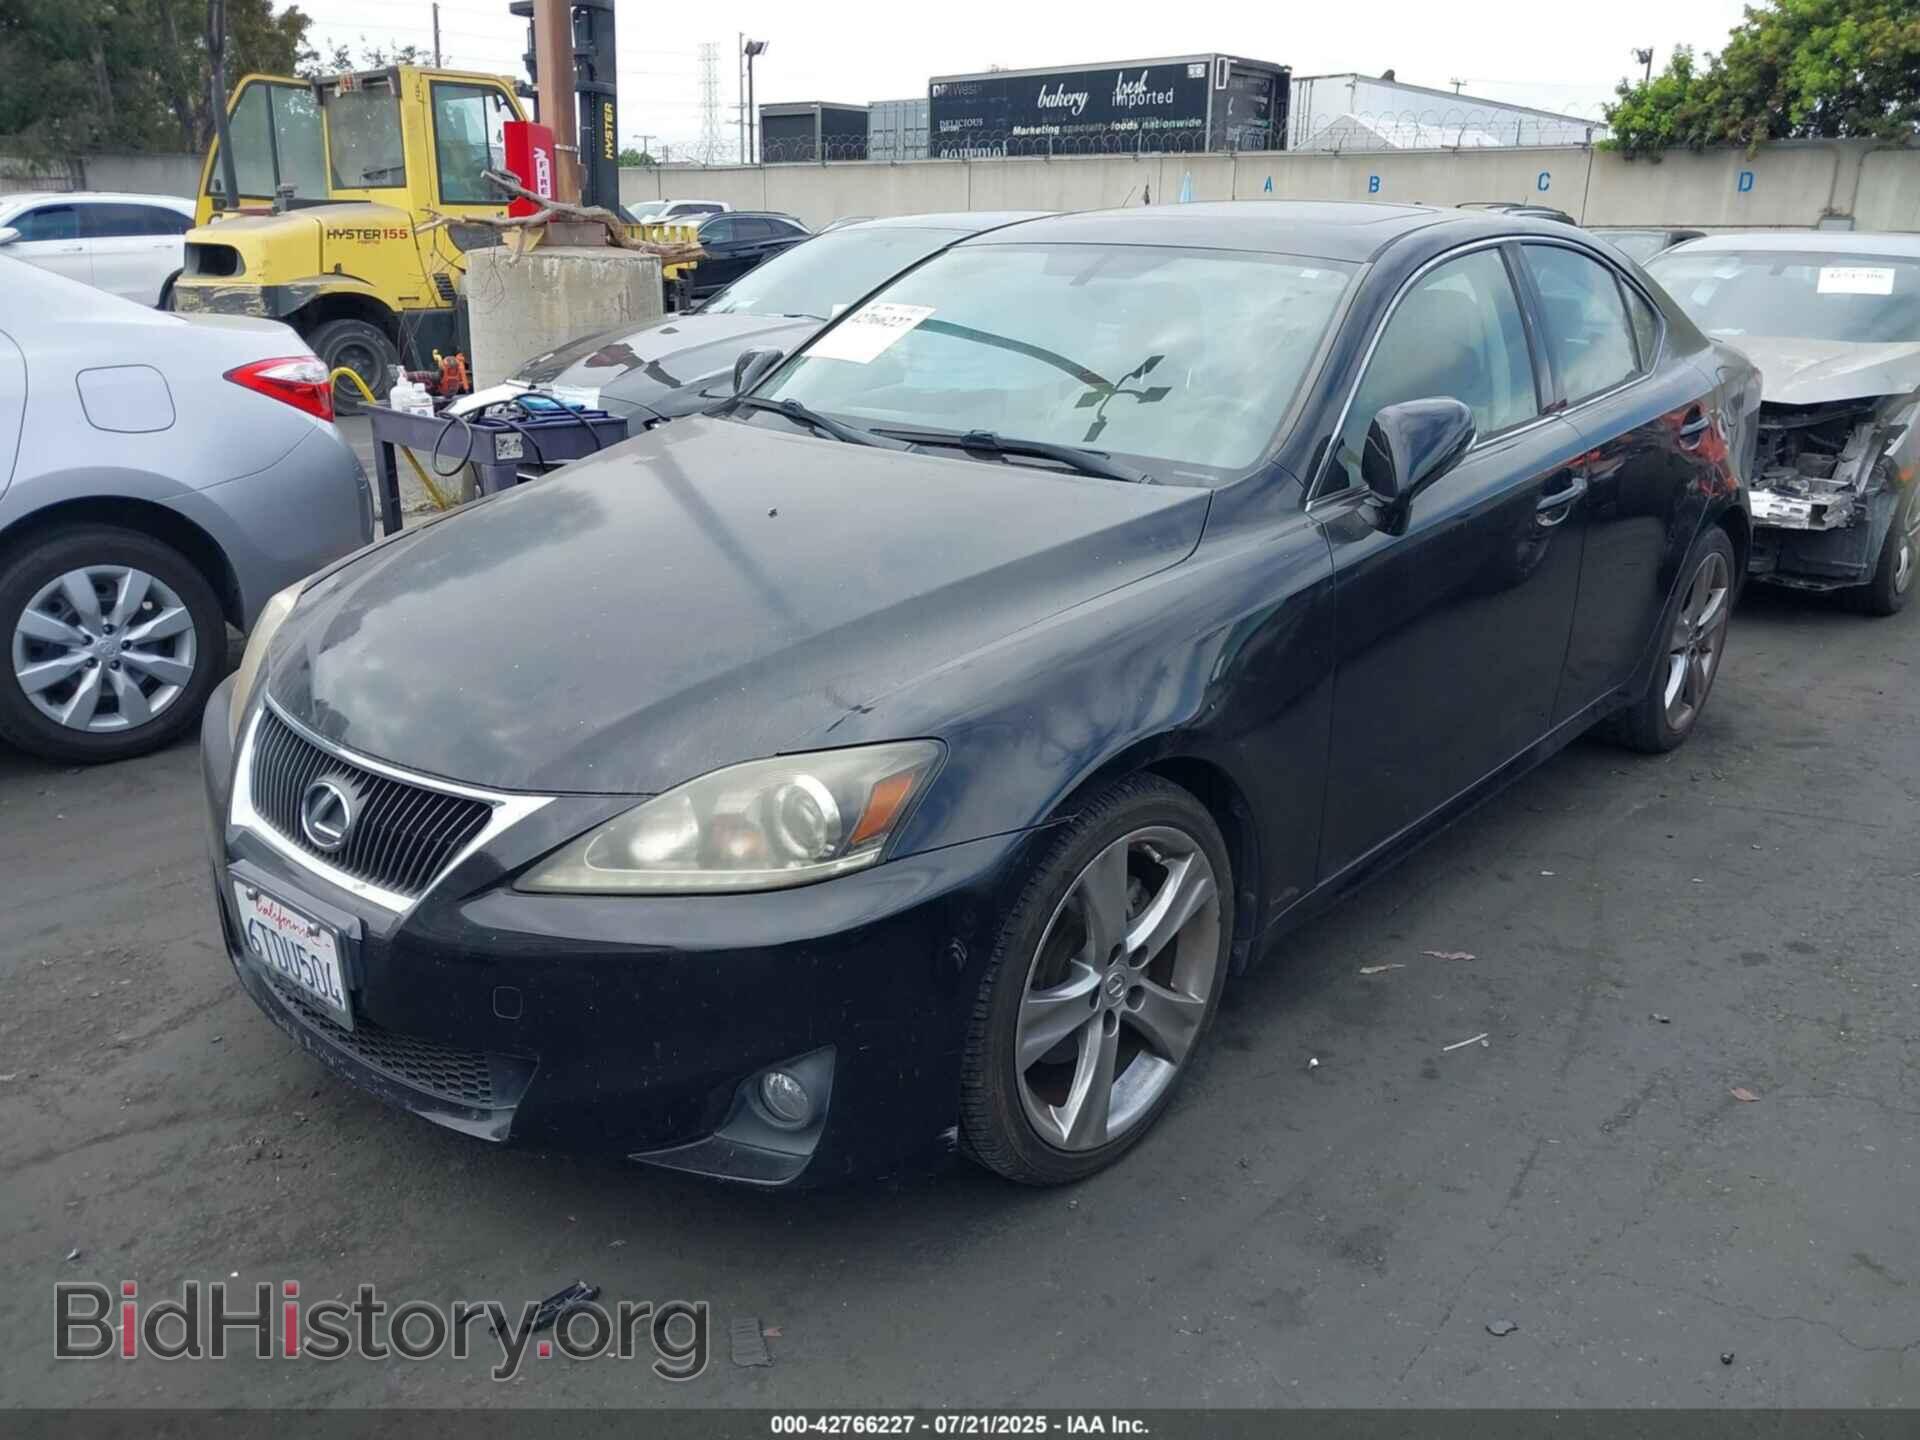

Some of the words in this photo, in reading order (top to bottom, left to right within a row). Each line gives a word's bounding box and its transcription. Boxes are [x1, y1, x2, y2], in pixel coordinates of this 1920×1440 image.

[1037, 83, 1089, 116] bakery
[1111, 88, 1174, 109] imported
[604, 102, 614, 160] HYSTER
[1012, 124, 1060, 136] Marketing
[1110, 120, 1139, 131] foods
[1141, 117, 1202, 130] nationwide
[539, 160, 549, 196] FIRE
[1263, 176, 1273, 193] A
[1368, 176, 1380, 193] B
[1537, 172, 1550, 191] C
[1737, 171, 1754, 193] D
[327, 229, 381, 240] HYSTER
[383, 228, 408, 240] 155
[248, 917, 344, 1007] 6TDU504
